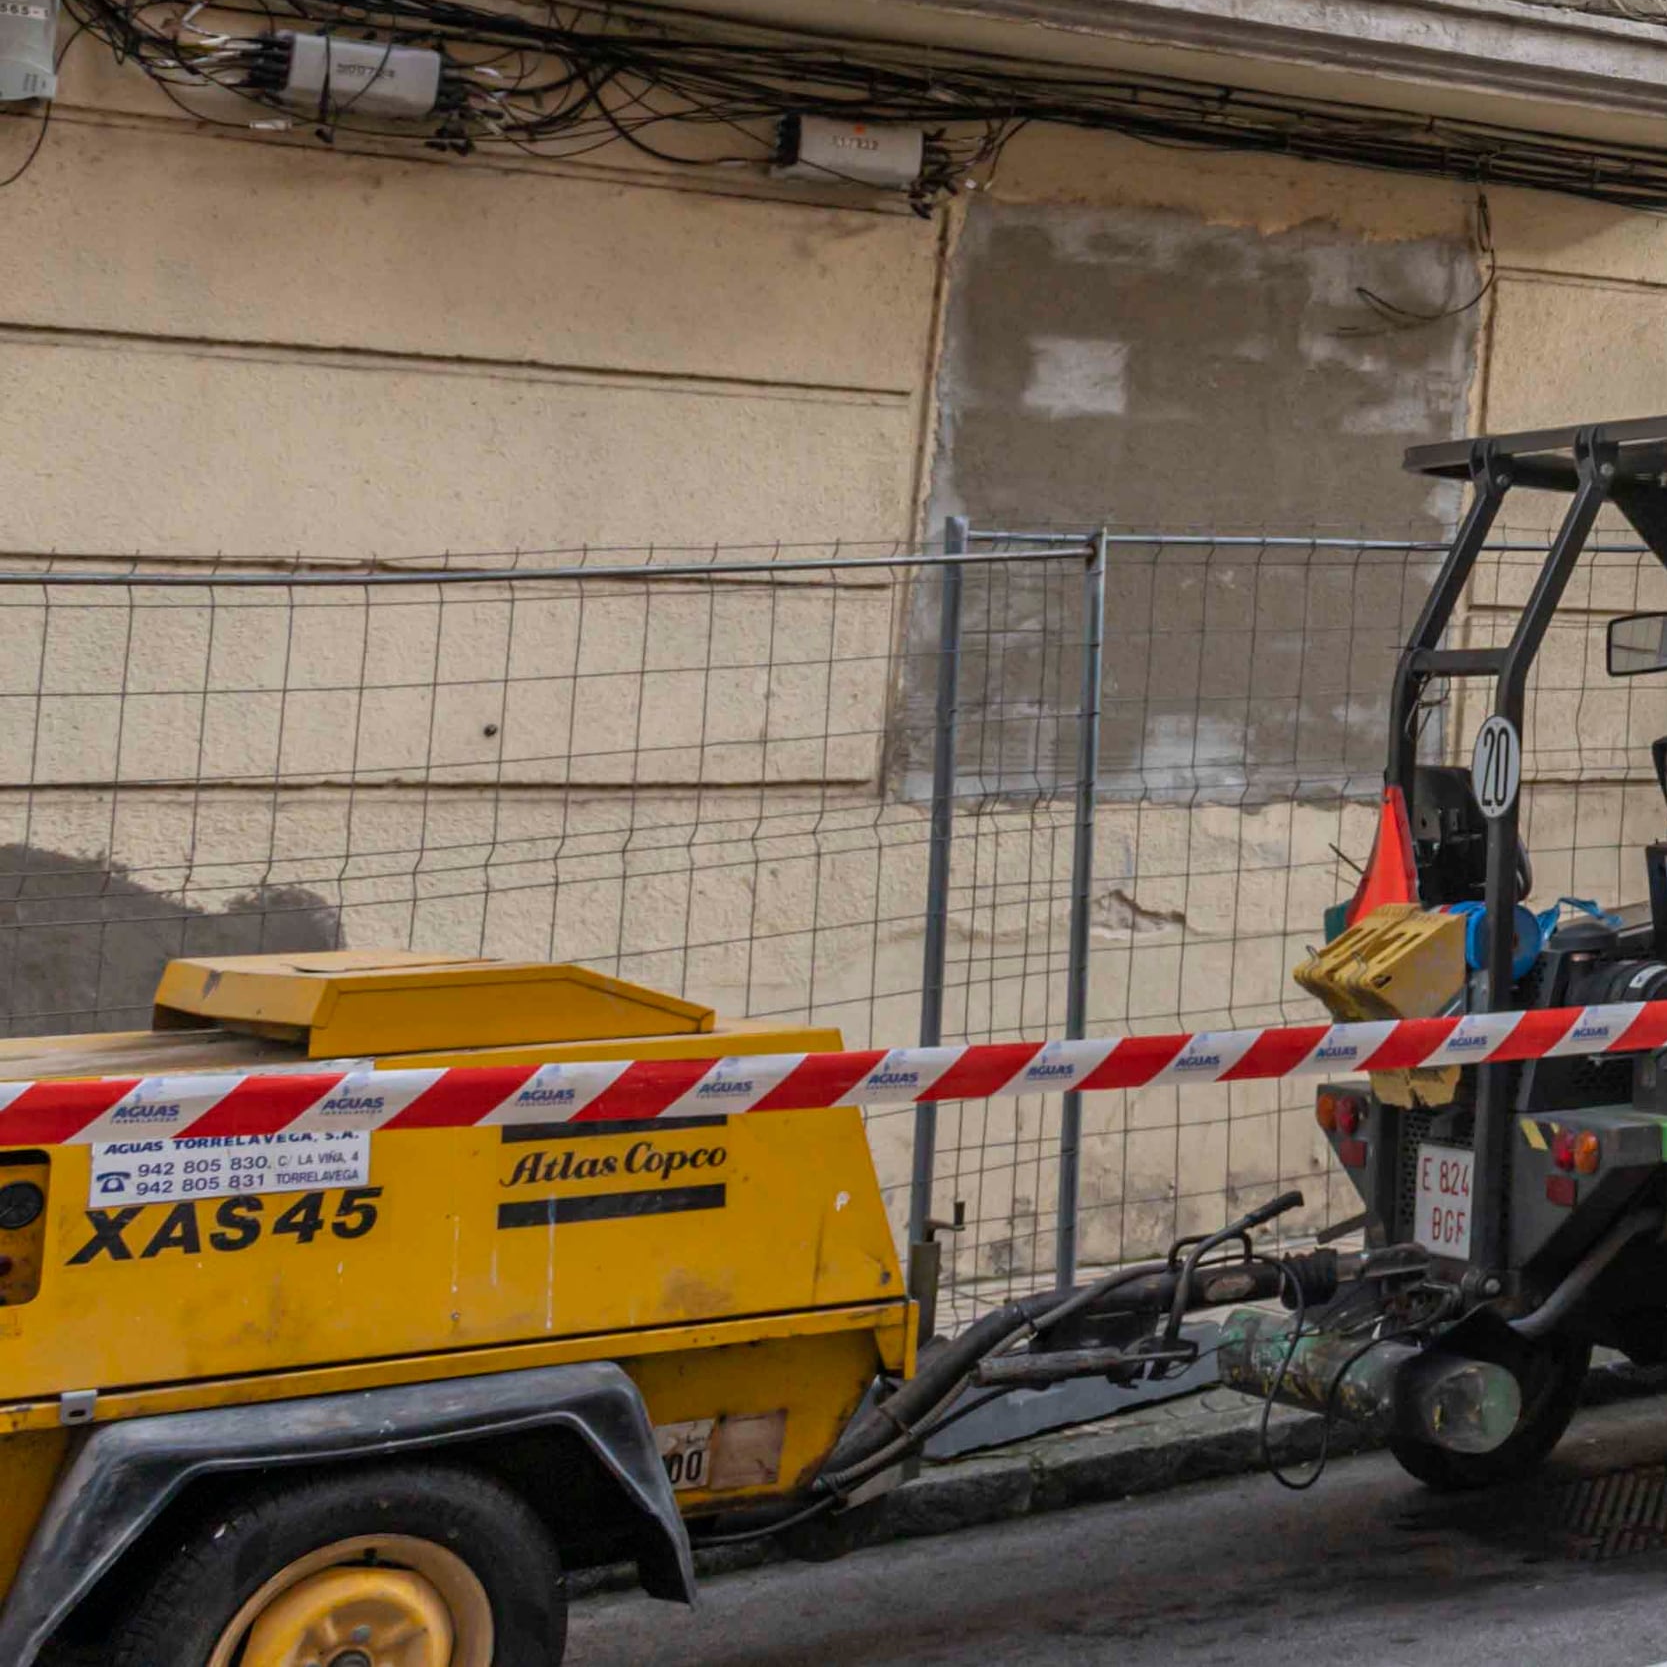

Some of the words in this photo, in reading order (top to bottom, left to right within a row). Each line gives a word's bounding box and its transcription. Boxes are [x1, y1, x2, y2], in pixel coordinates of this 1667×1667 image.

[1482, 727, 1509, 806] 20
[1572, 1026, 1608, 1038] AGUAS
[1448, 1036, 1487, 1048] AGUAS
[1316, 1046, 1357, 1058] AGUAS
[1175, 1055, 1220, 1068] AGUAS
[1027, 1064, 1074, 1076] AGUAS
[868, 1072, 918, 1083] AGUAS
[699, 1081, 752, 1093] AGUAS
[518, 1089, 575, 1102] AGUAS
[323, 1097, 384, 1110] AGUAS
[113, 1104, 180, 1119] AGUAS
[104, 1141, 163, 1155] AGUAS
[138, 1163, 174, 1178] 942
[184, 1158, 220, 1174] 805
[278, 1155, 292, 1167] C/
[298, 1153, 313, 1165] LA
[352, 1151, 359, 1162] 4
[499, 1151, 618, 1188] Atlas
[624, 1141, 727, 1181] Copco
[1422, 1157, 1433, 1191] E
[136, 1182, 173, 1196] 942
[182, 1178, 219, 1193] 805
[229, 1174, 265, 1190] 831
[276, 1170, 359, 1185] TORRELAVEGA
